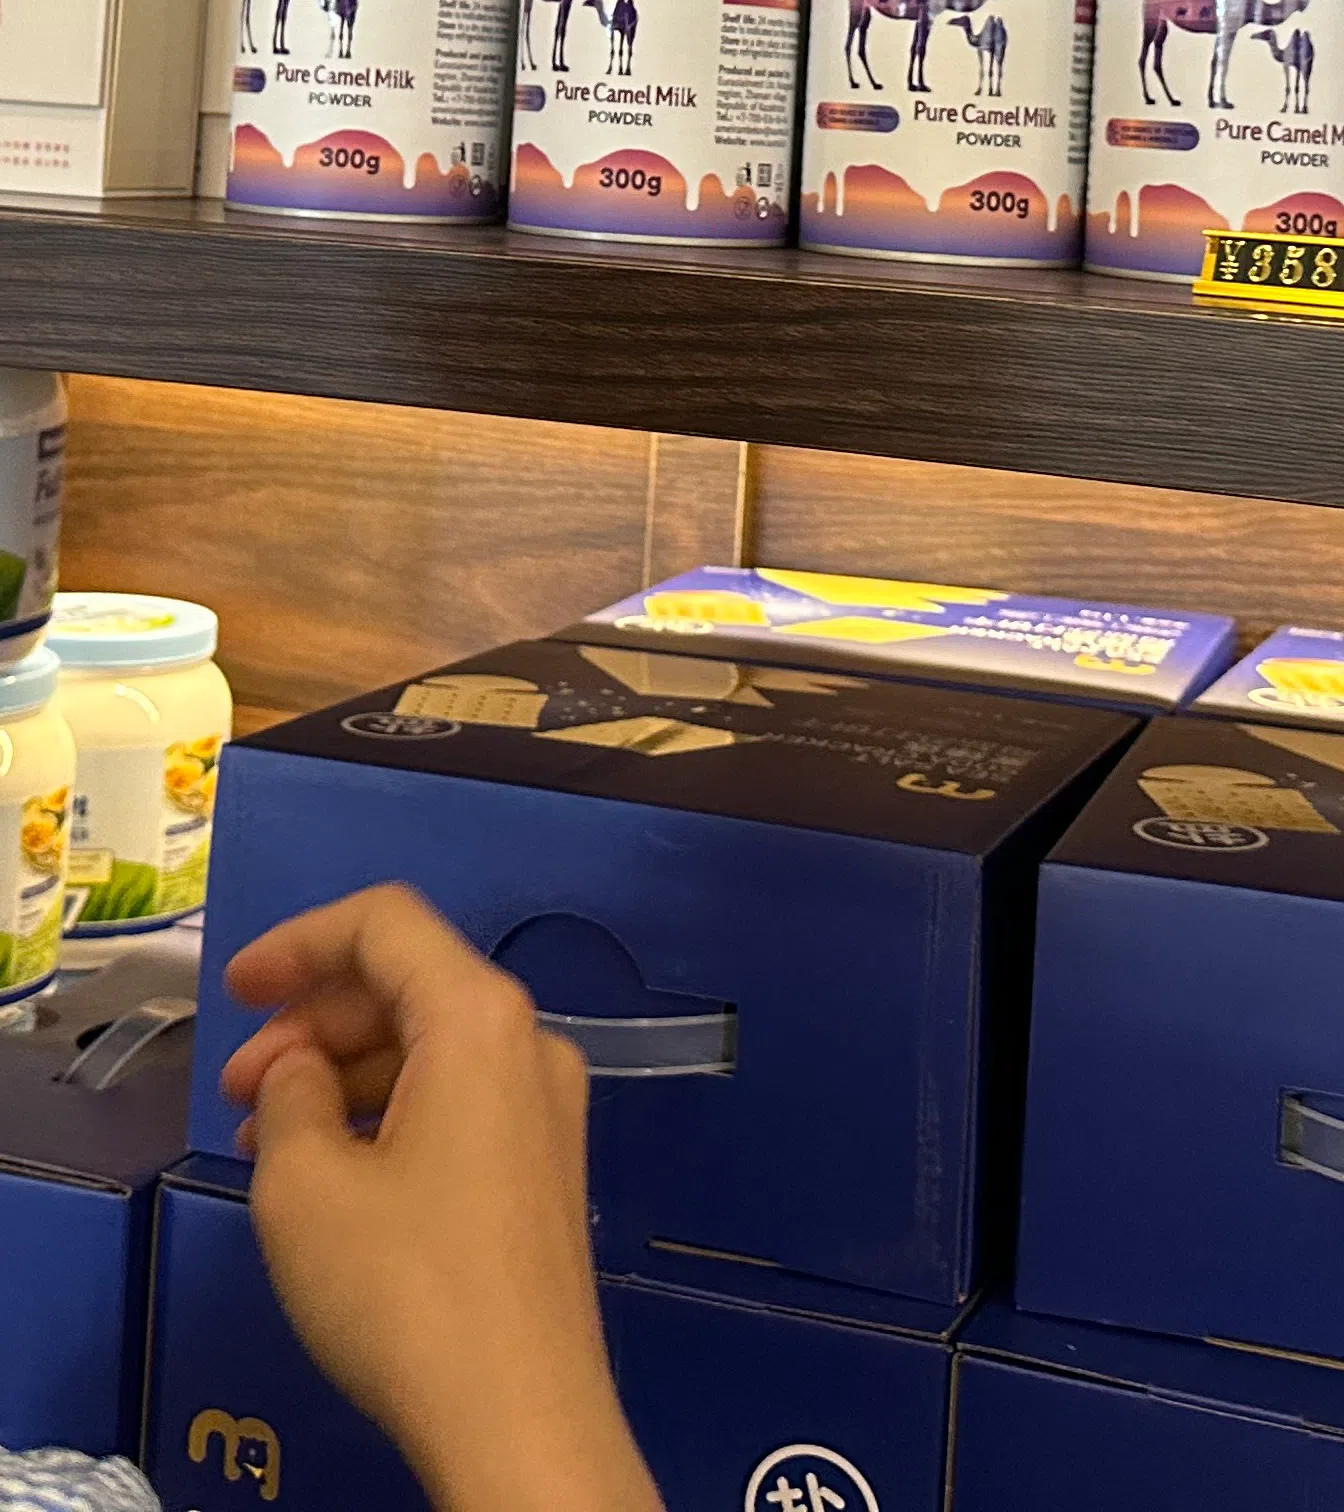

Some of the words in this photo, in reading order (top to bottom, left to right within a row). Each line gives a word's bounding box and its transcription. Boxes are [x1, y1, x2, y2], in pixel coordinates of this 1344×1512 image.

[276, 63, 309, 84] Pure
[314, 66, 371, 86] Camel
[376, 70, 414, 89] Milk
[308, 93, 372, 108] POWDER
[556, 80, 589, 102] Pure
[594, 84, 650, 105] Camel
[656, 87, 697, 108] Milk
[588, 110, 652, 126] POWDER
[914, 101, 957, 123] Pure
[962, 104, 1020, 127] Camel
[1024, 107, 1056, 128] Milk
[957, 133, 1021, 148] POWDER
[1216, 119, 1261, 141] Pure
[1267, 121, 1328, 145] Camel
[320, 148, 380, 174] 300g
[1261, 151, 1328, 168] POWDER
[600, 168, 662, 196] 300g
[970, 191, 1029, 218] 300g
[1219, 240, 1338, 288] ¥358
